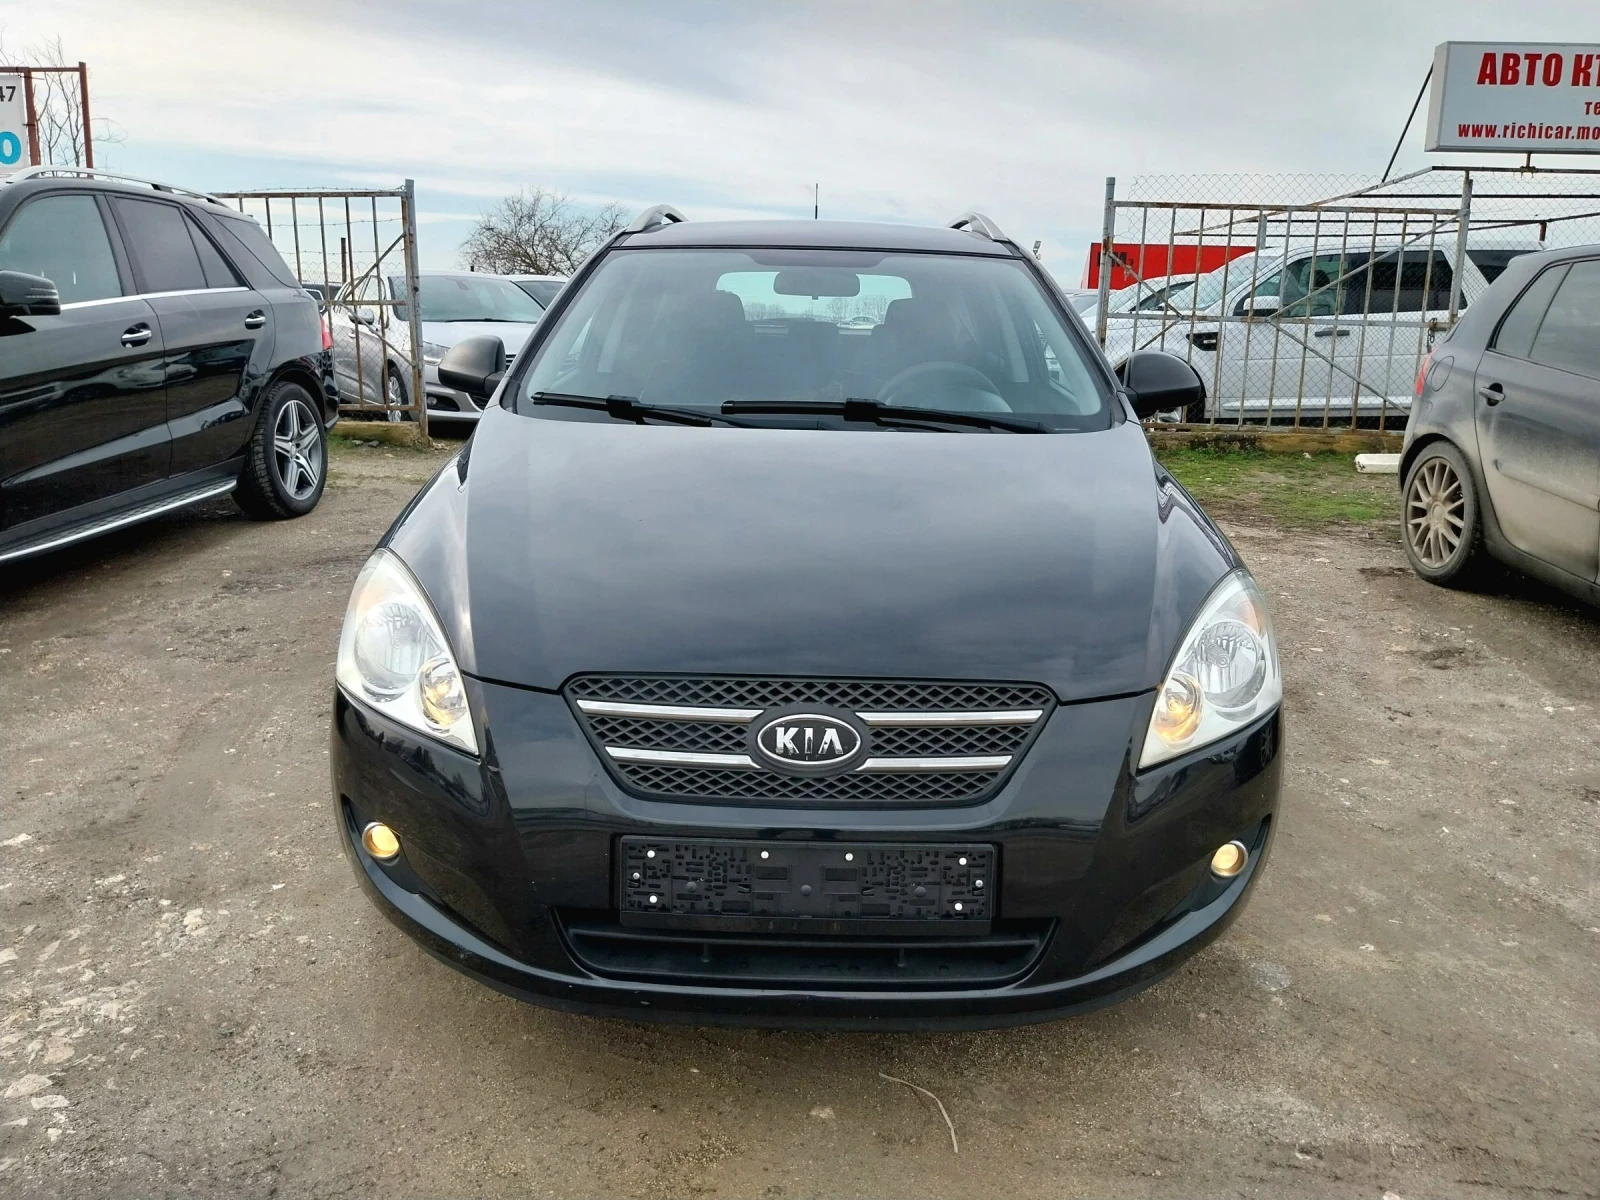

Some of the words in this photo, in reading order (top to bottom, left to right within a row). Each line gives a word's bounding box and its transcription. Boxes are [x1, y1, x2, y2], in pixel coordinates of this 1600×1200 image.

[1476, 52, 1563, 87] АВТО
[1571, 54, 1600, 87] К
[1458, 122, 1600, 140] www.richicar.mo
[775, 727, 844, 754] KIA
